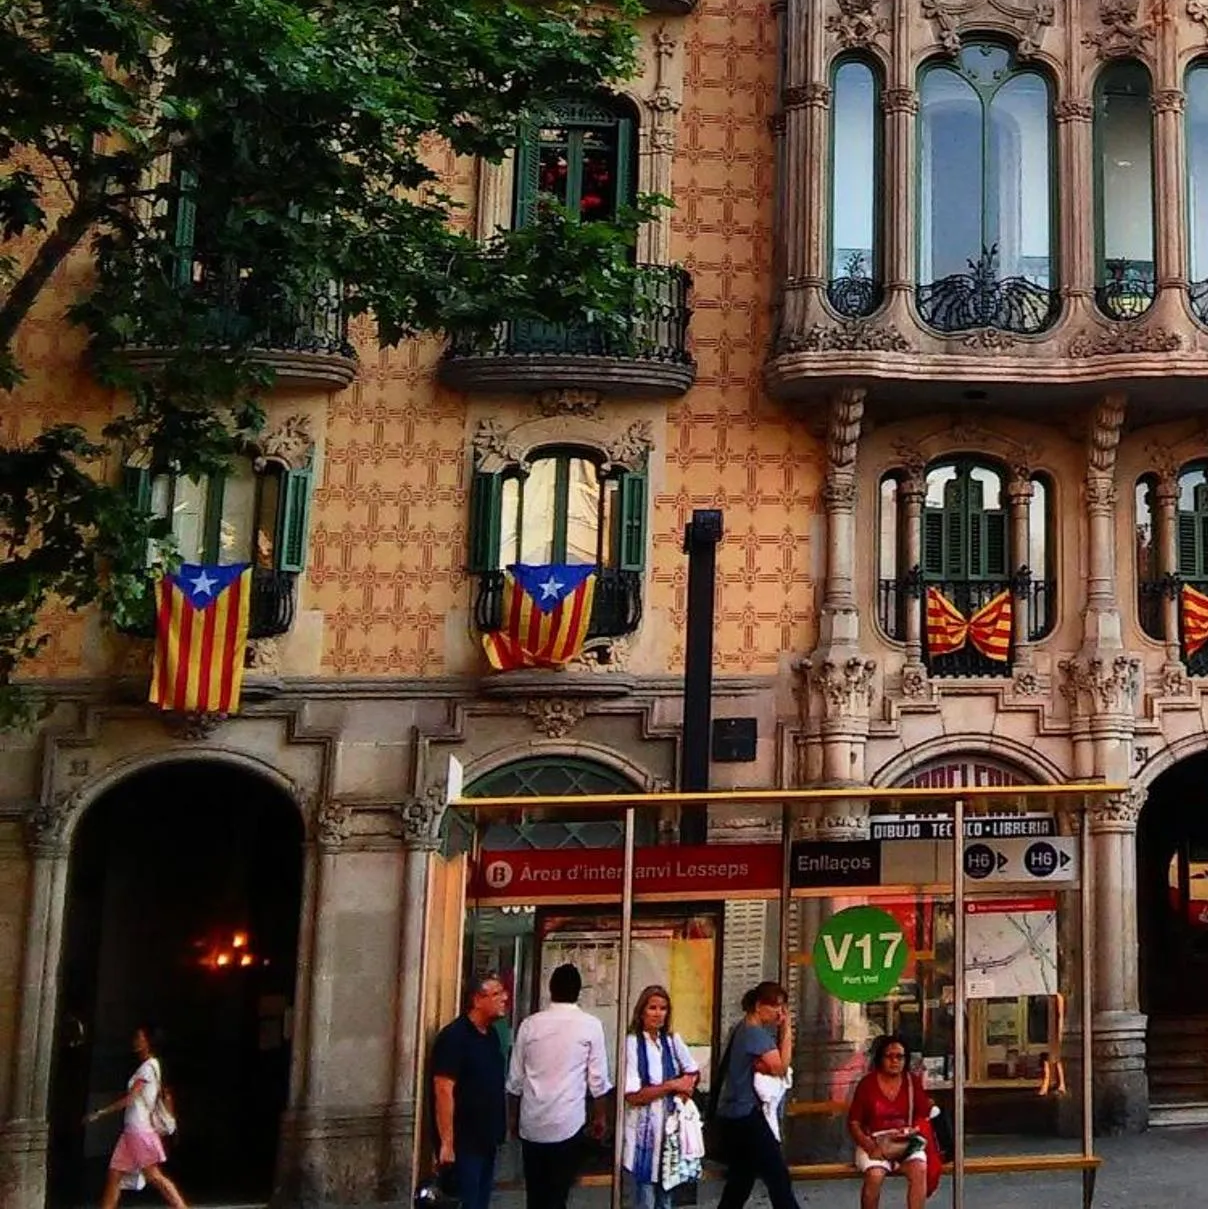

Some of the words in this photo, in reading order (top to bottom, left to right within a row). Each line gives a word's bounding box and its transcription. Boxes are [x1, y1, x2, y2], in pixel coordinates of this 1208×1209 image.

[1135, 747, 1148, 762] 31
[873, 823, 920, 838] DIBUJO
[931, 822, 983, 837] TECICO
[993, 820, 1049, 835] LIBRERIA
[798, 855, 872, 874] Enllaços
[968, 854, 990, 868] H6
[1031, 852, 1053, 866] H6
[567, 861, 671, 880] d'interanvi
[676, 861, 748, 879] Lesseps
[823, 932, 903, 971] V17
